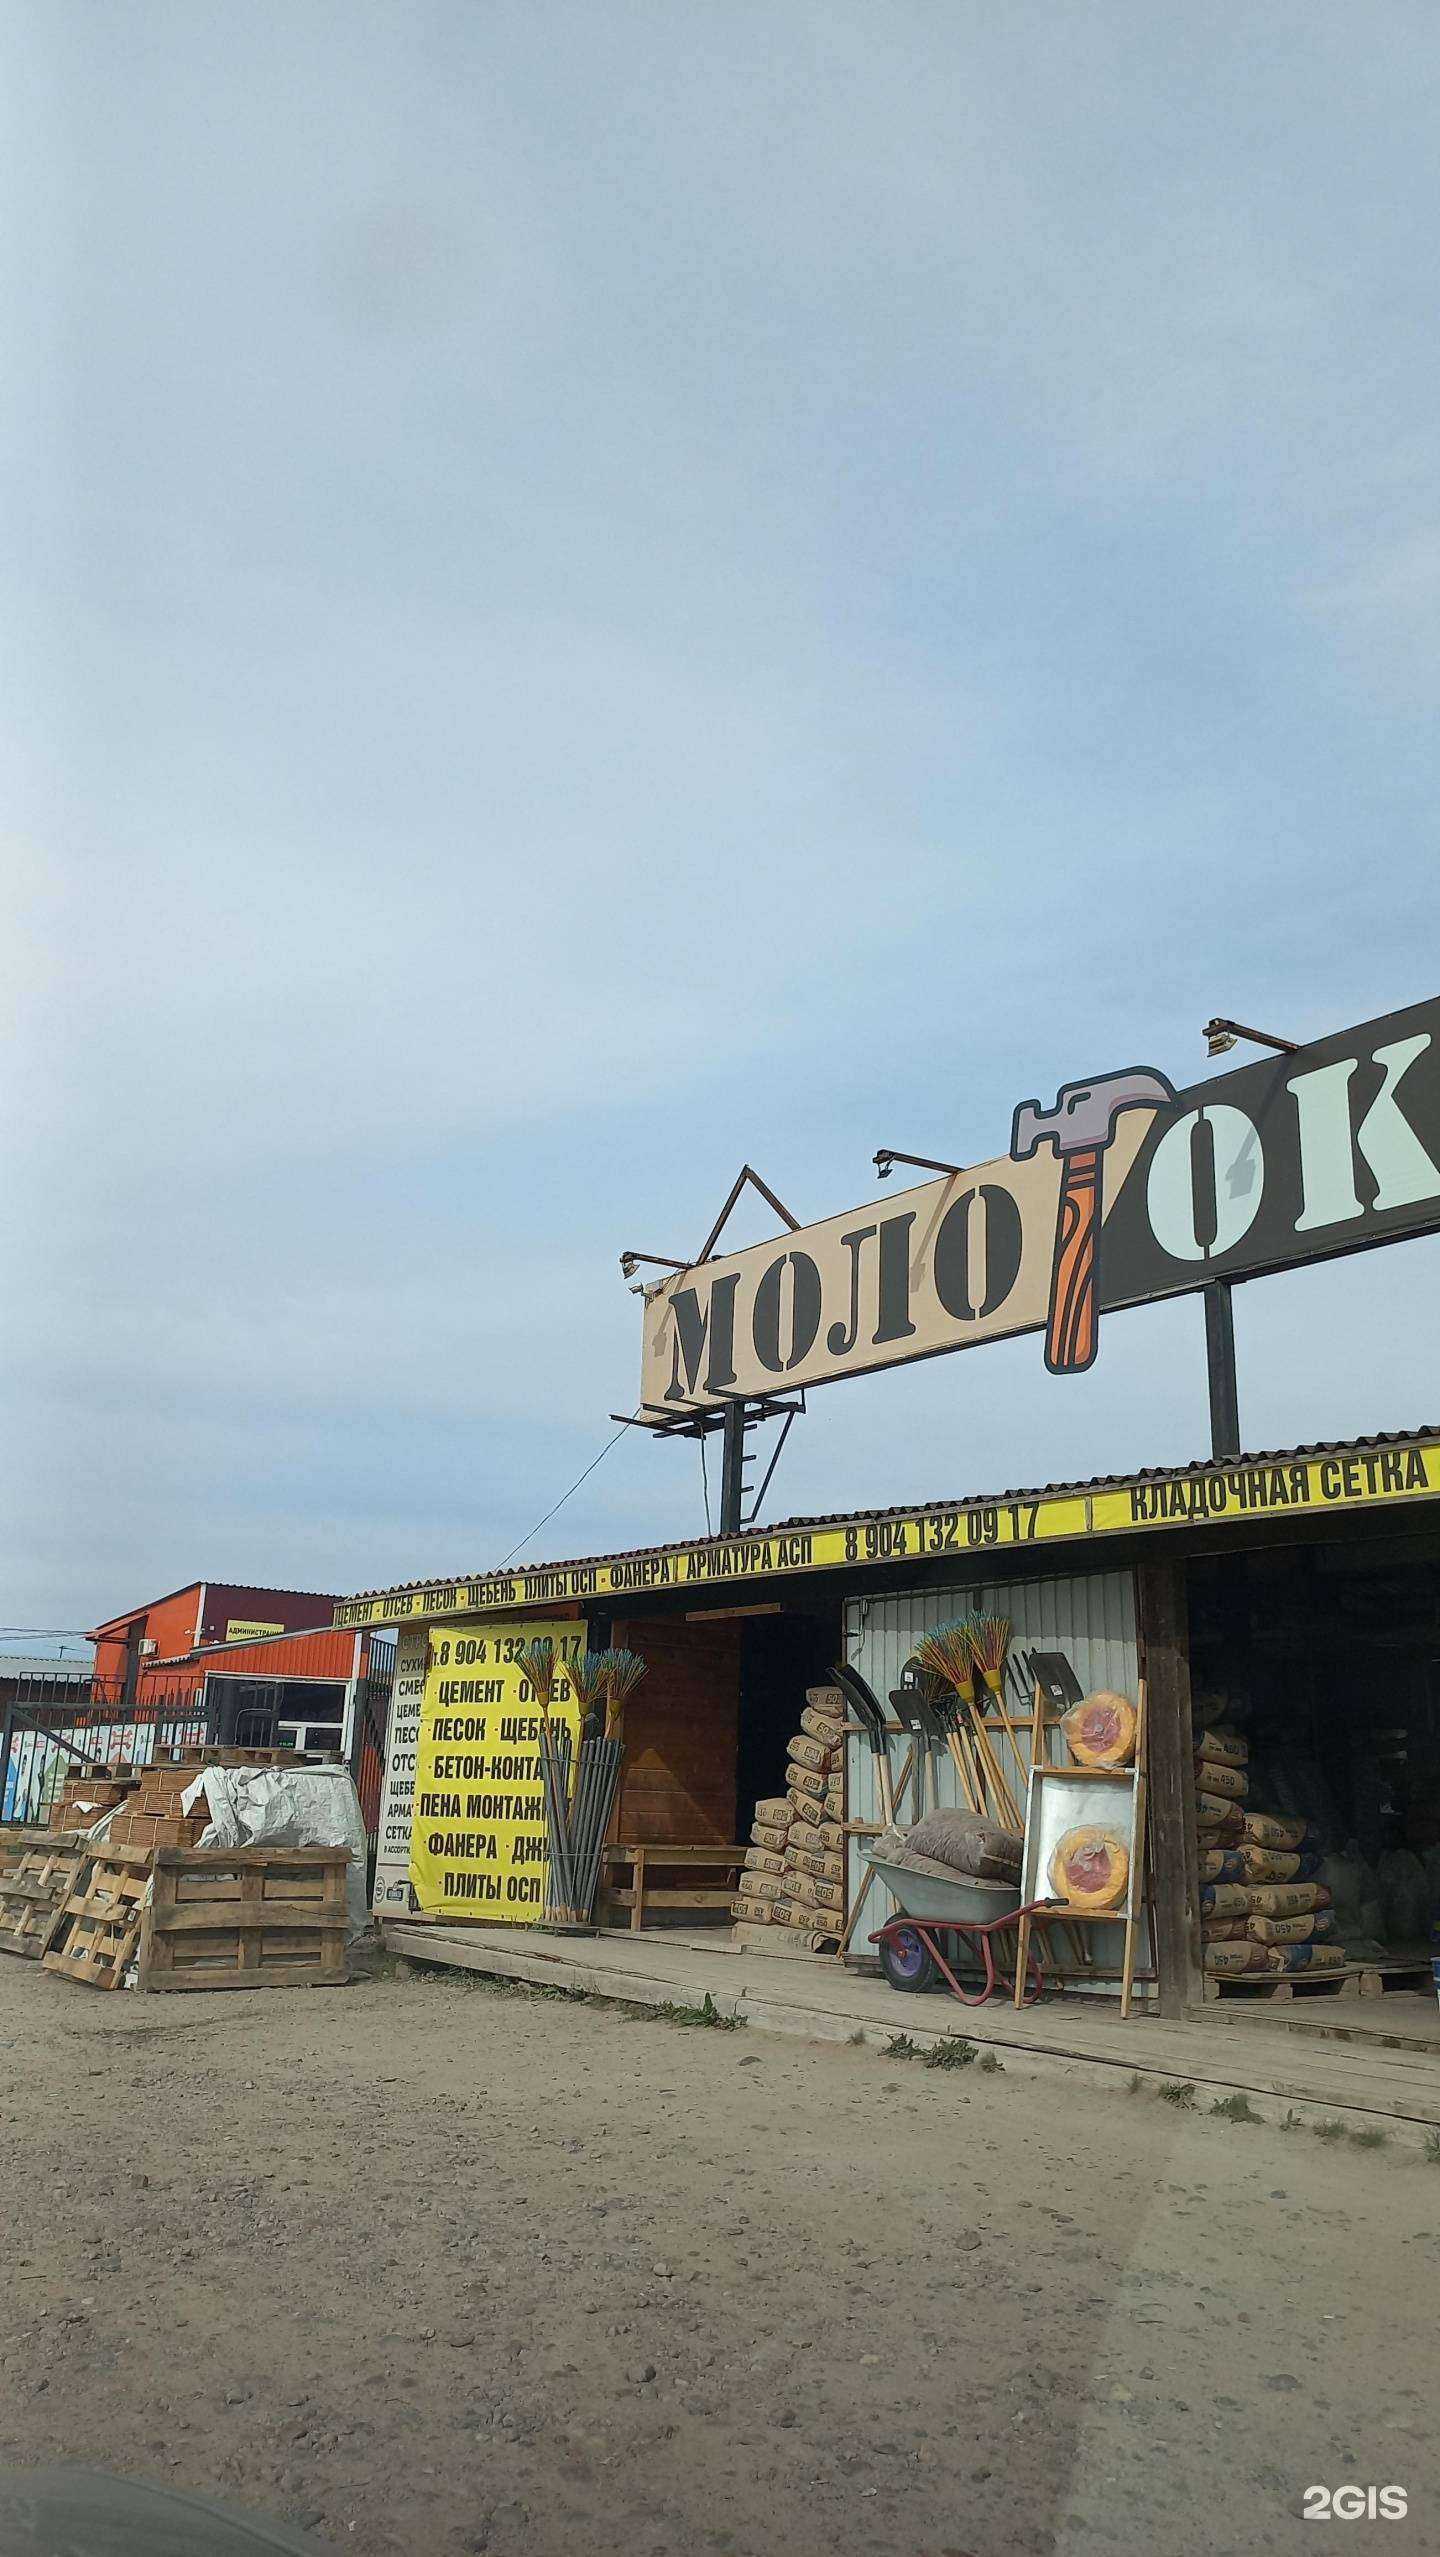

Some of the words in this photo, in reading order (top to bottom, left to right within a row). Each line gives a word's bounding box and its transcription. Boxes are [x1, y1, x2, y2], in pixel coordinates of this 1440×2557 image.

[1130, 1464, 1308, 1522] КЛАДОЧНАЯ
[1320, 1448, 1429, 1500] СЕТКА
[844, 1526, 858, 1561] 8
[866, 1520, 907, 1558] 904
[916, 1513, 959, 1550] 132
[967, 1509, 998, 1545] 09
[1007, 1502, 1040, 1541] 17
[686, 1541, 772, 1579] АРМАТУРА
[777, 1536, 812, 1573] АСП
[382, 1595, 413, 1618] ОТСЕВ
[422, 1587, 457, 1612] ПЕСОК
[467, 1581, 516, 1607] ЩЕБЕНЬ
[524, 1570, 567, 1600] ПЛИТЫ
[571, 1568, 597, 1594] ОСП
[610, 1557, 670, 1589] ФАНЕРА
[455, 1640, 487, 1665] 904
[494, 1637, 525, 1663] 132
[560, 1636, 581, 1661] 17
[439, 1679, 505, 1707] ЦЕМЕНТ
[432, 1718, 487, 1741] ПЕСОК
[392, 1754, 416, 1771] ОТС
[434, 1755, 545, 1780] БЕТОН-КОНТА
[388, 1804, 414, 1817] АРМА
[420, 1793, 461, 1817] ПЕНА
[467, 1795, 546, 1821] МОНТАЖ
[428, 1833, 498, 1859] ФАНЕРА
[444, 1872, 502, 1900] ПЛИТЫ
[507, 1876, 541, 1902] ОСП
